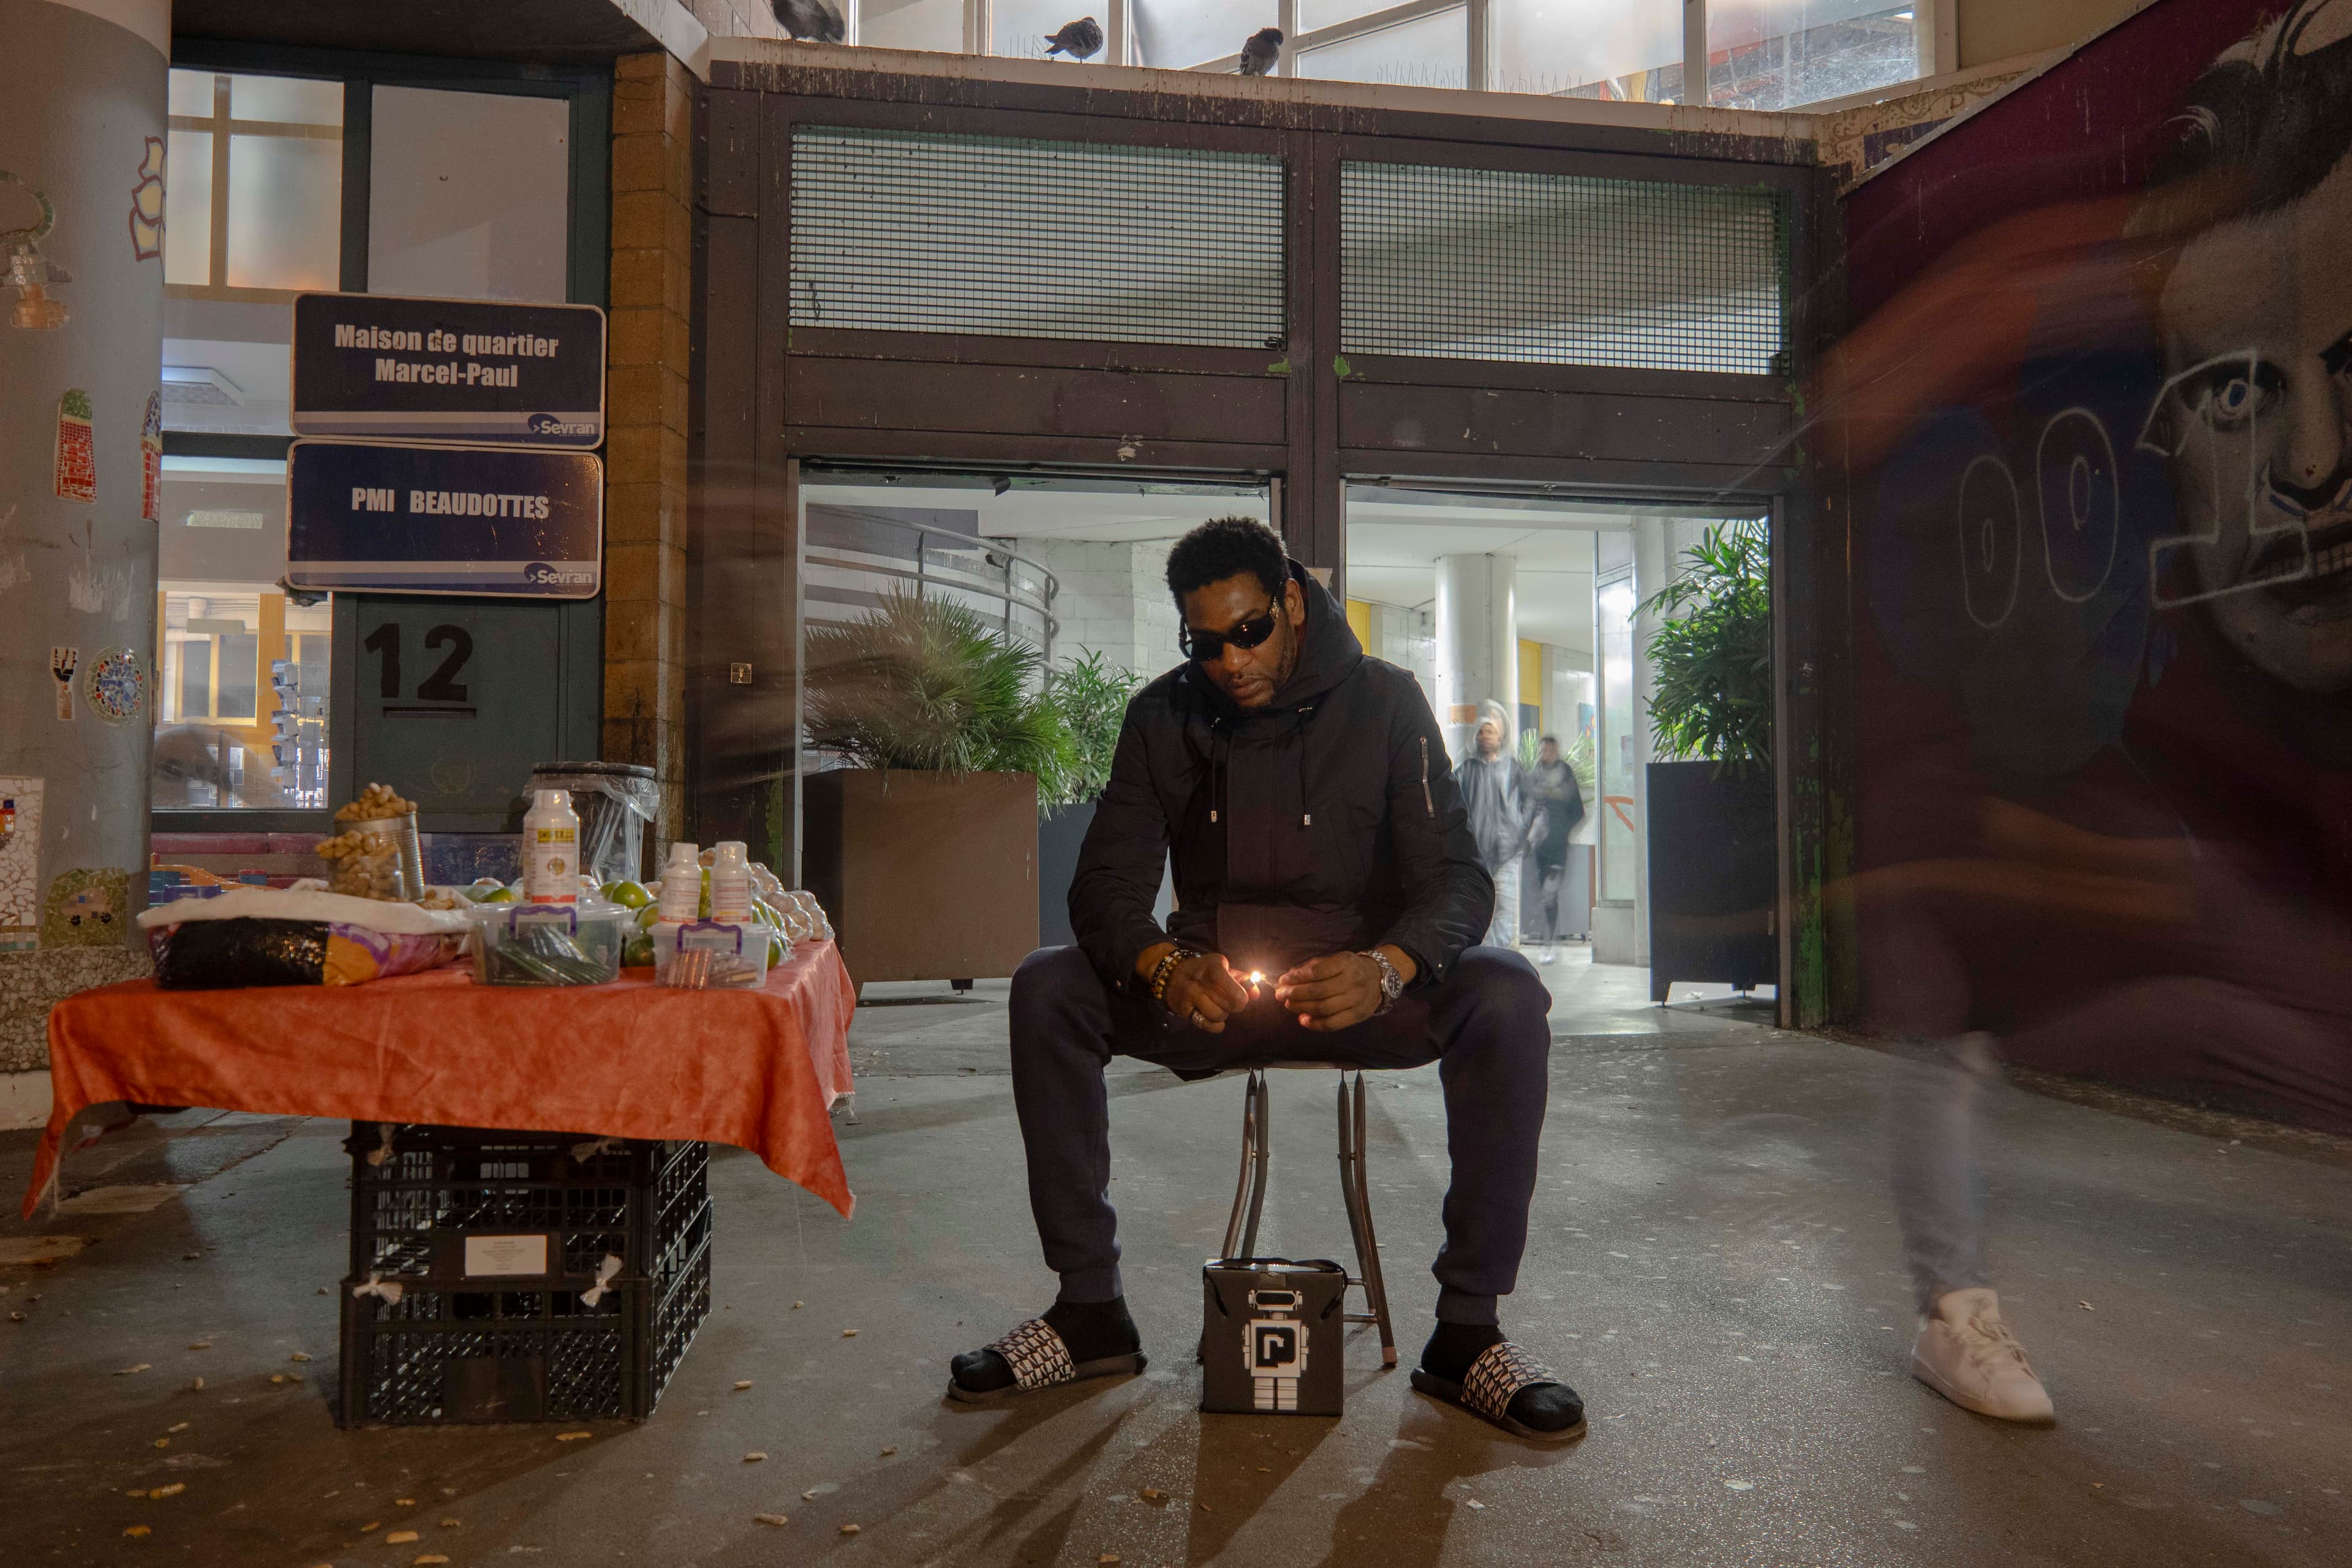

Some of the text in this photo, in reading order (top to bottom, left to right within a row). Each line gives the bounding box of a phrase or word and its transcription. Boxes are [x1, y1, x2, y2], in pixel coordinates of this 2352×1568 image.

[334, 324, 559, 358] Maison de quartier
[375, 358, 518, 387] Marcel-Paul
[541, 420, 595, 435] Sevran
[352, 488, 549, 519] PMI BEAUDOTTES
[537, 570, 592, 584] Sevran
[364, 623, 473, 702] 12
